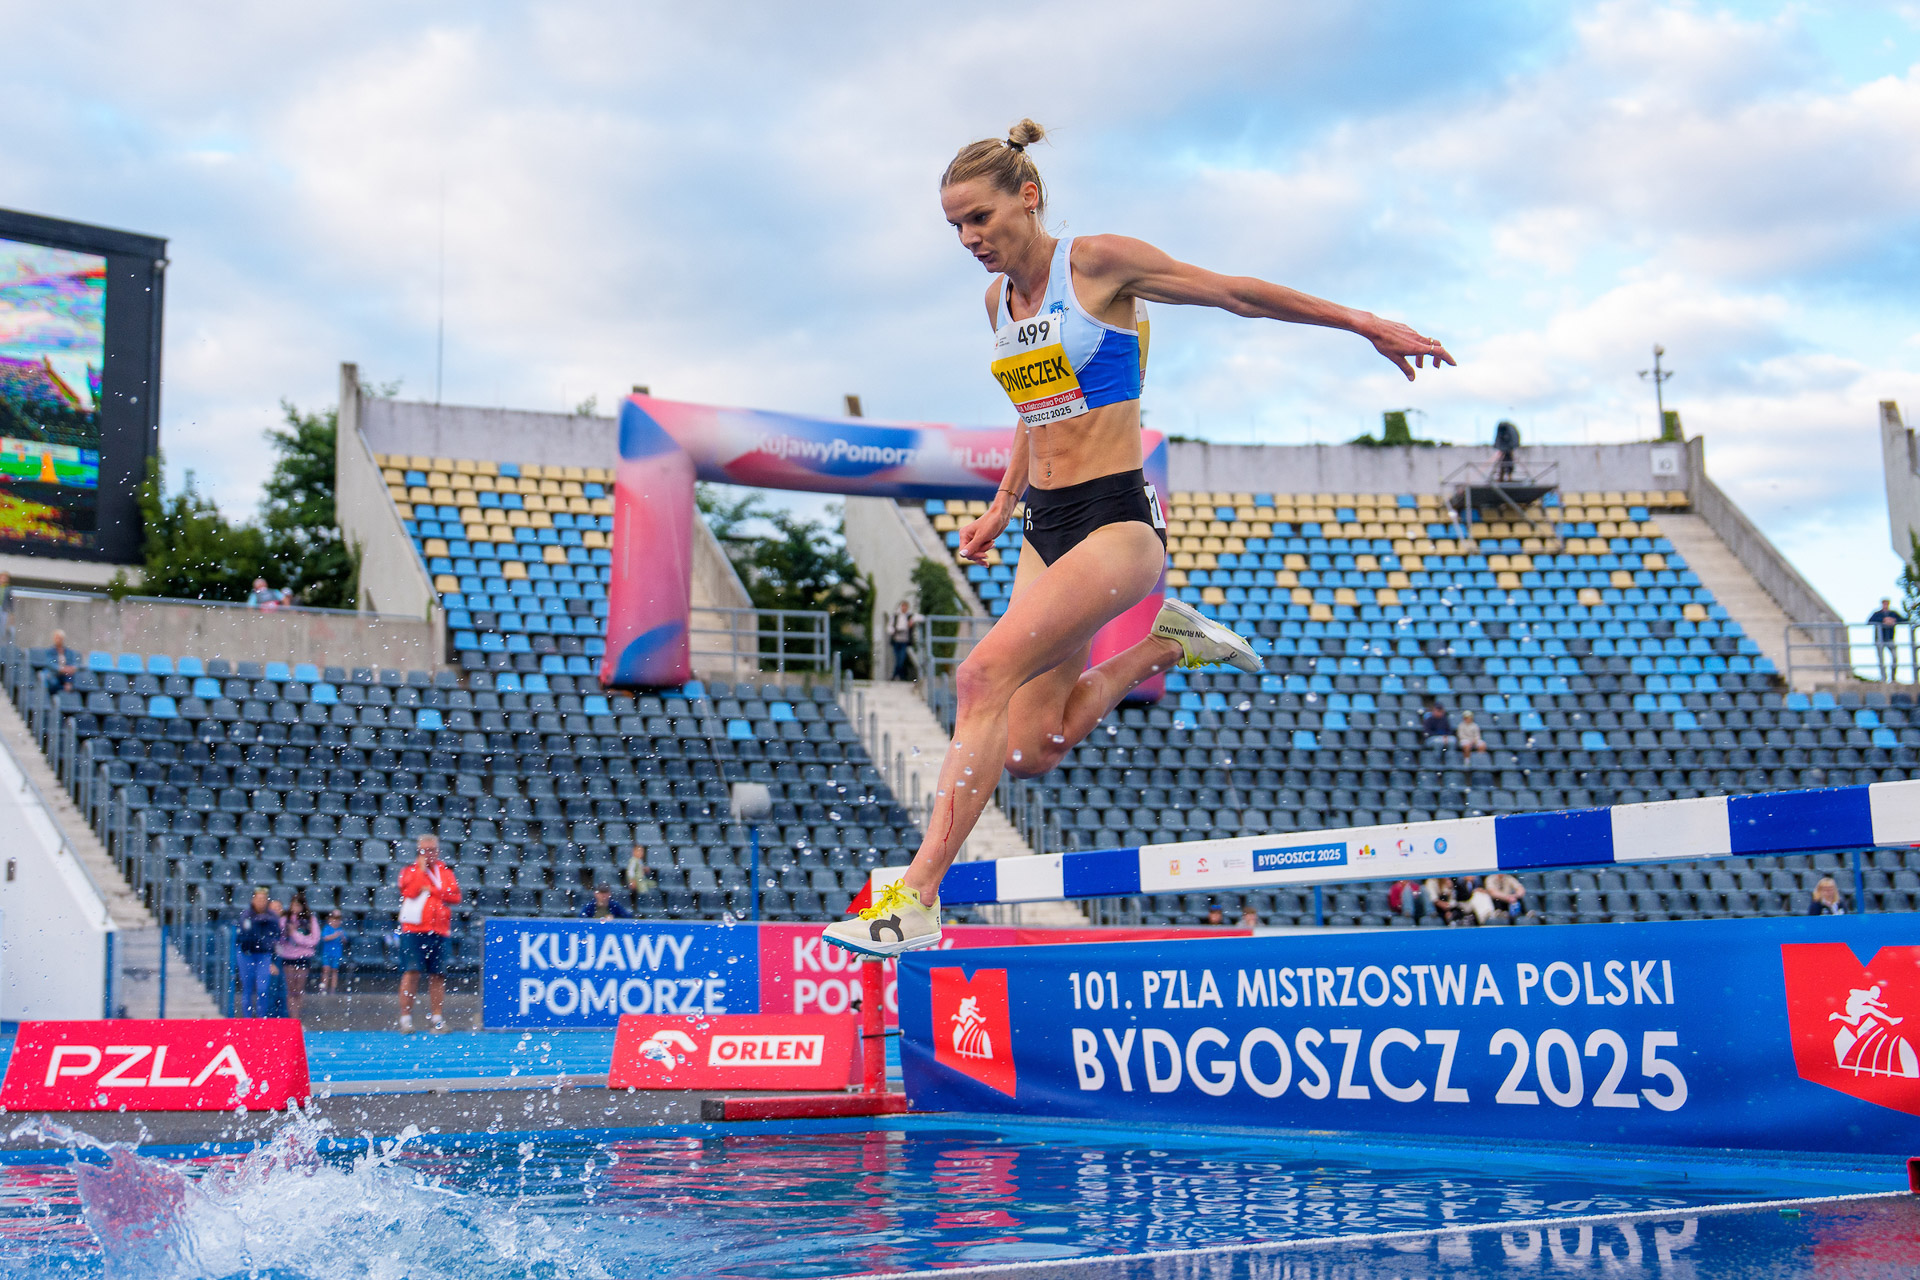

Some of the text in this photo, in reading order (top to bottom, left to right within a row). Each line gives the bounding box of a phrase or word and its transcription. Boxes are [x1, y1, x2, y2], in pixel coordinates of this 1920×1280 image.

[1018, 320, 1050, 346] 499
[1055, 391, 1077, 405] Polski
[1022, 405, 1072, 424] GOSZCZ 2025
[1151, 491, 1160, 521] 1
[1159, 624, 1195, 638] RUNNING
[1258, 850, 1316, 867] BYDGOSZCZ
[1317, 848, 1341, 862] 2025
[519, 931, 694, 972] KUJAWY
[519, 977, 727, 1016] POMORZE
[1069, 959, 1675, 1010] 101. PZLA MISTRZOSTWA POLSKI
[717, 1041, 815, 1060] ORLEN
[44, 1044, 251, 1088] PZLA
[1071, 1026, 1688, 1112] BYDGOSZCZ 2025
